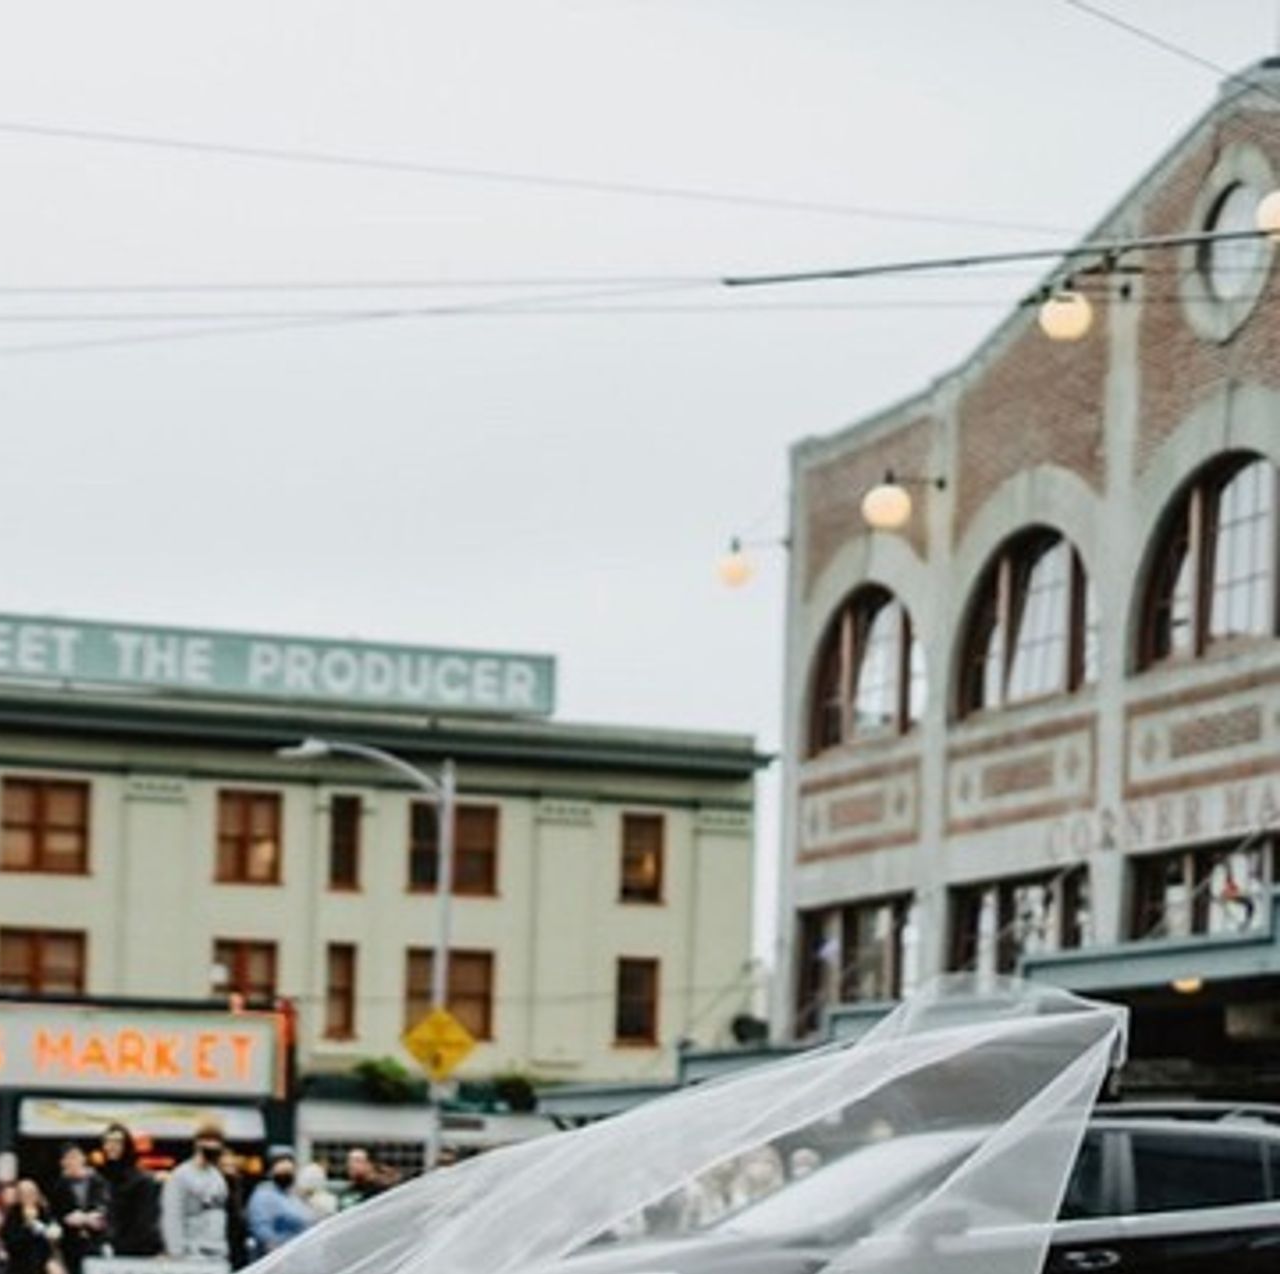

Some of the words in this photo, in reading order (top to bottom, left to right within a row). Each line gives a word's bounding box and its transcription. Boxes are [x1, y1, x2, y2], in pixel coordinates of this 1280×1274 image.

[113, 631, 213, 685] THE
[248, 641, 539, 707] PRODUCER
[31, 1026, 255, 1083] MARKET
